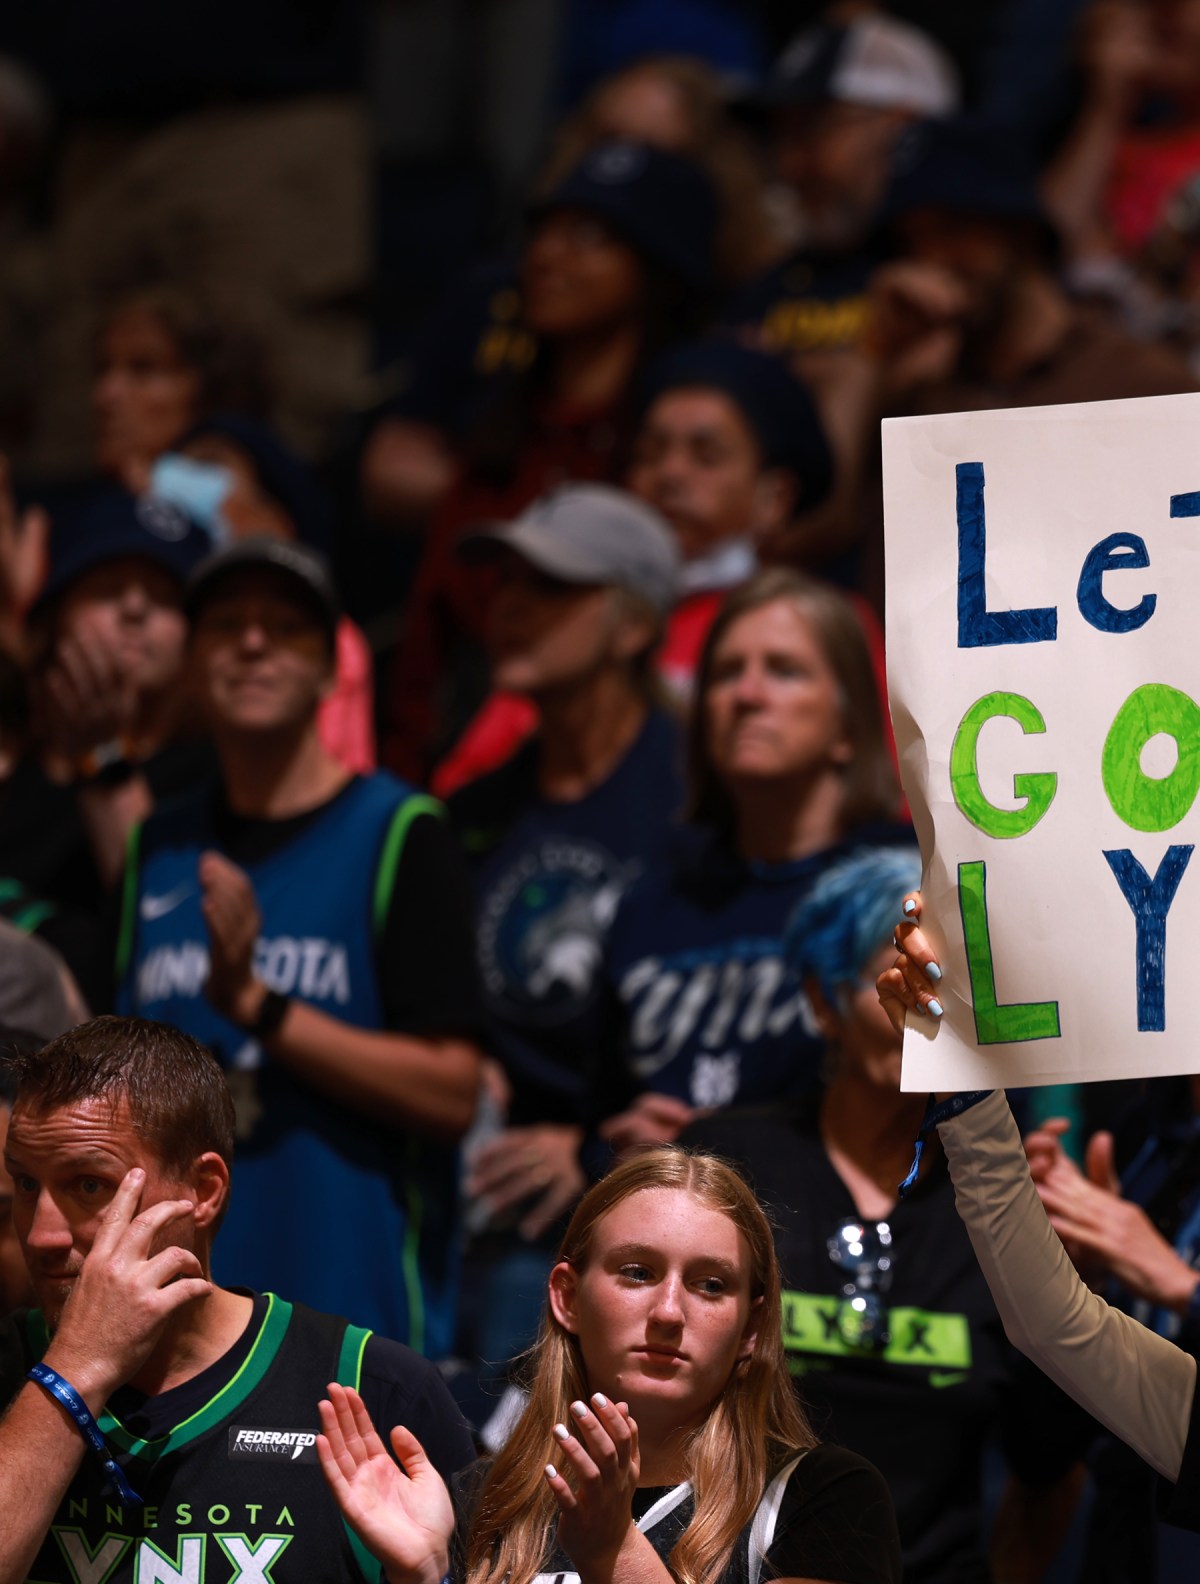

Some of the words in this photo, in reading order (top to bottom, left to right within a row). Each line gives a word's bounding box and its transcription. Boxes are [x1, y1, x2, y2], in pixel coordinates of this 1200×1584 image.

[786, 1305, 933, 1355] LYX
[232, 1442, 289, 1454] INSURANCE
[235, 1430, 316, 1447] FEDERATED
[69, 1497, 295, 1528] NNESOTA
[40, 1525, 294, 1584] YNX
